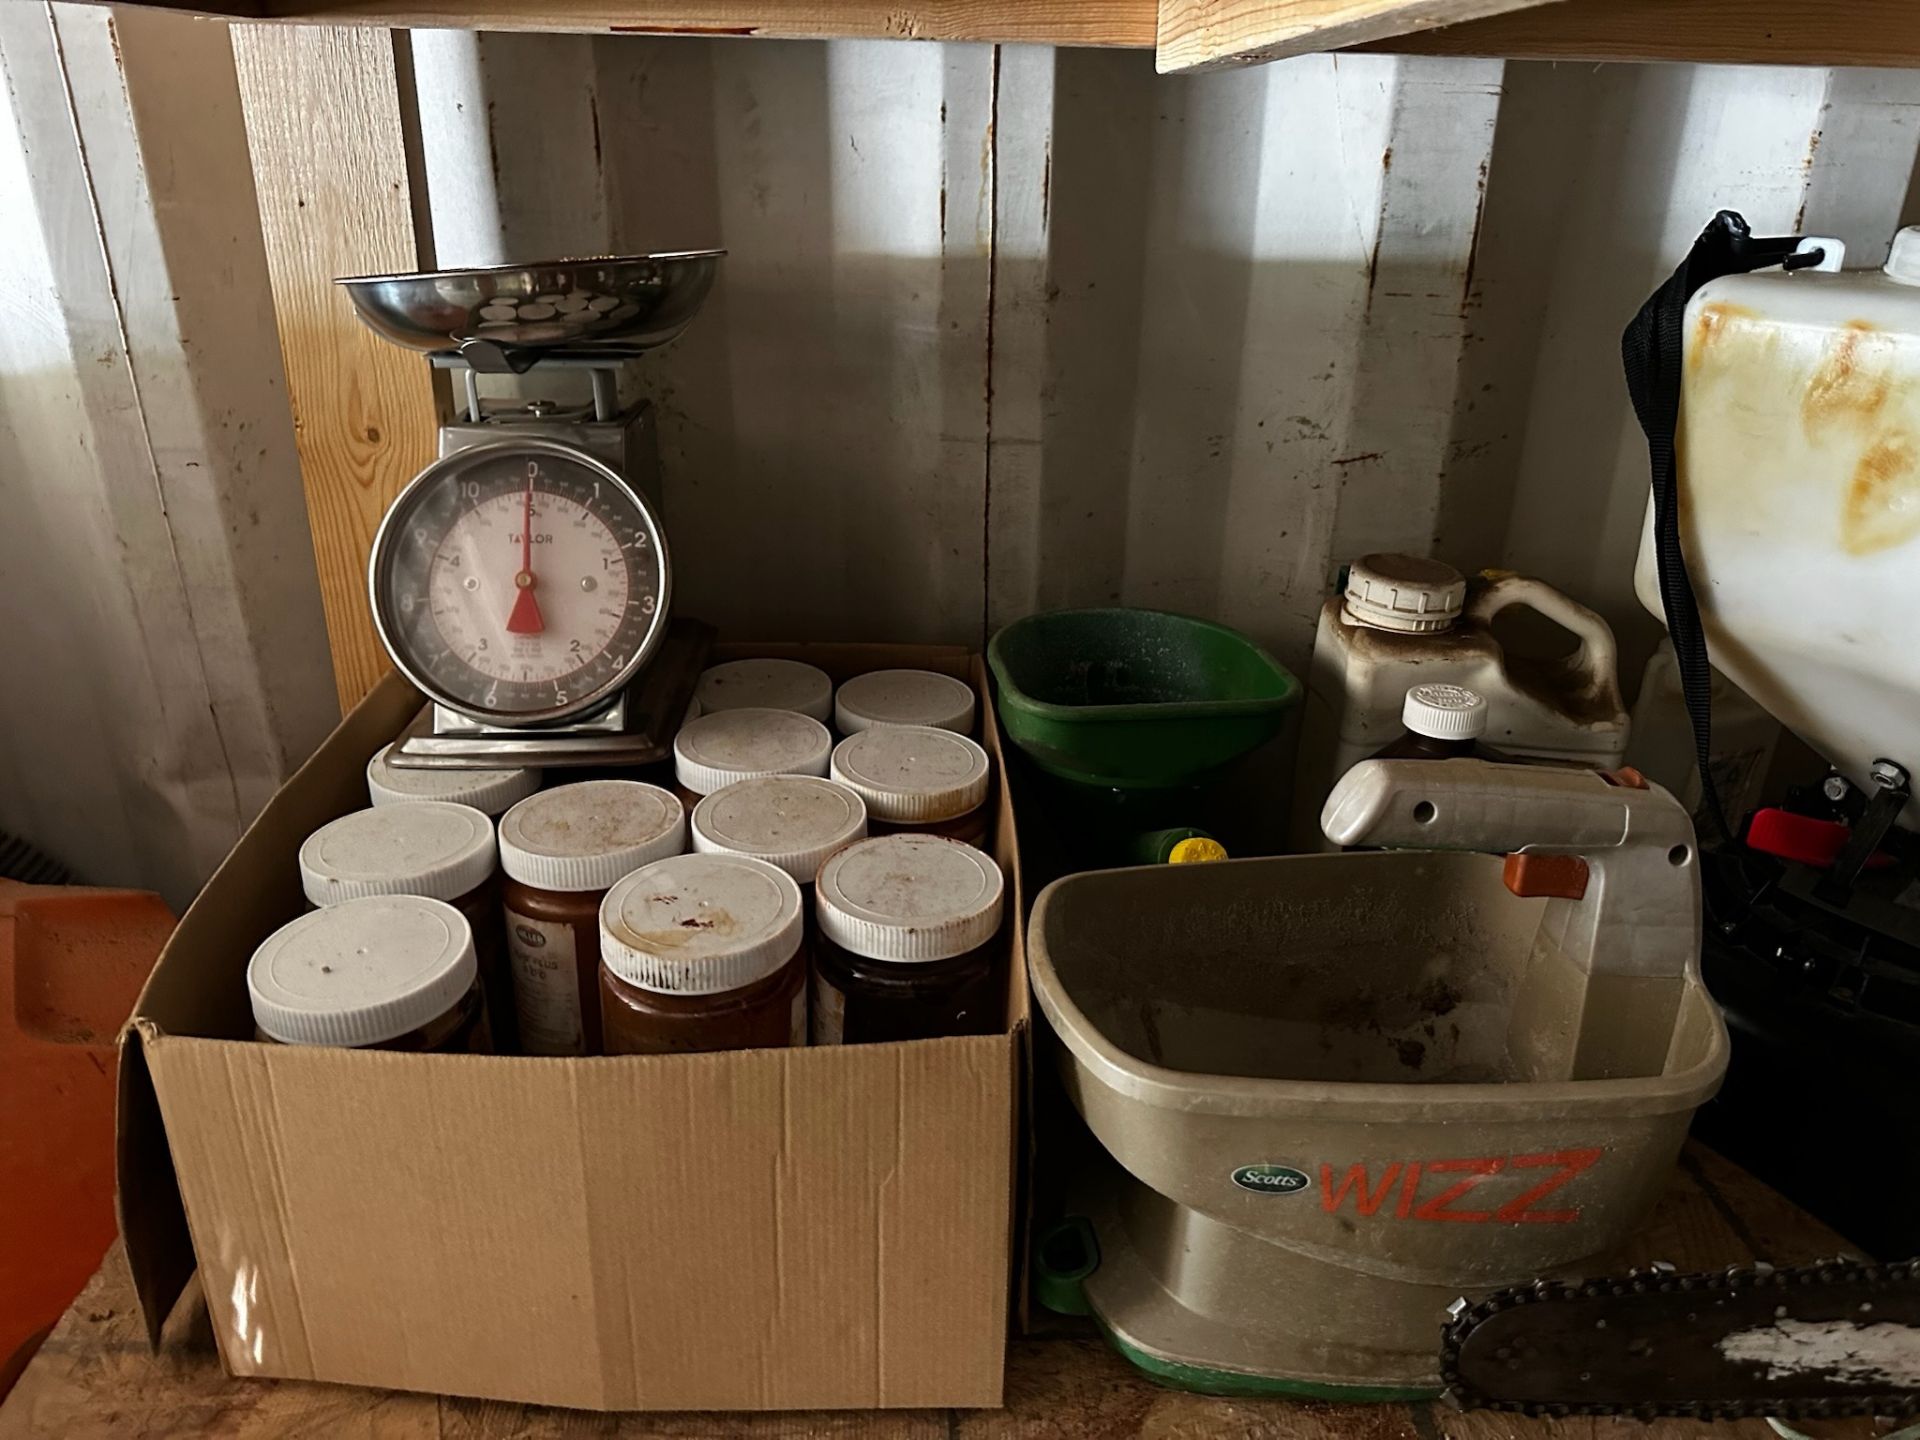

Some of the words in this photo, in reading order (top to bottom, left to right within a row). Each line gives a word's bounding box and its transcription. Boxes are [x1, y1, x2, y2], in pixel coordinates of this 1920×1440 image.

[528, 461, 538, 478] 0
[461, 481, 480, 498] 10
[594, 482, 600, 498] 1
[414, 528, 427, 545] 9
[632, 531, 647, 548] 2
[450, 555, 461, 567] 4
[602, 557, 609, 570] 1
[401, 593, 415, 612] 8
[642, 596, 655, 614] 3
[478, 638, 488, 651] 3
[570, 639, 580, 652] 2
[612, 655, 624, 669] 4
[485, 690, 496, 706] 6
[556, 691, 568, 706] 5
[1241, 1169, 1299, 1187] Scotts
[1319, 1147, 1603, 1224] WIZZ
